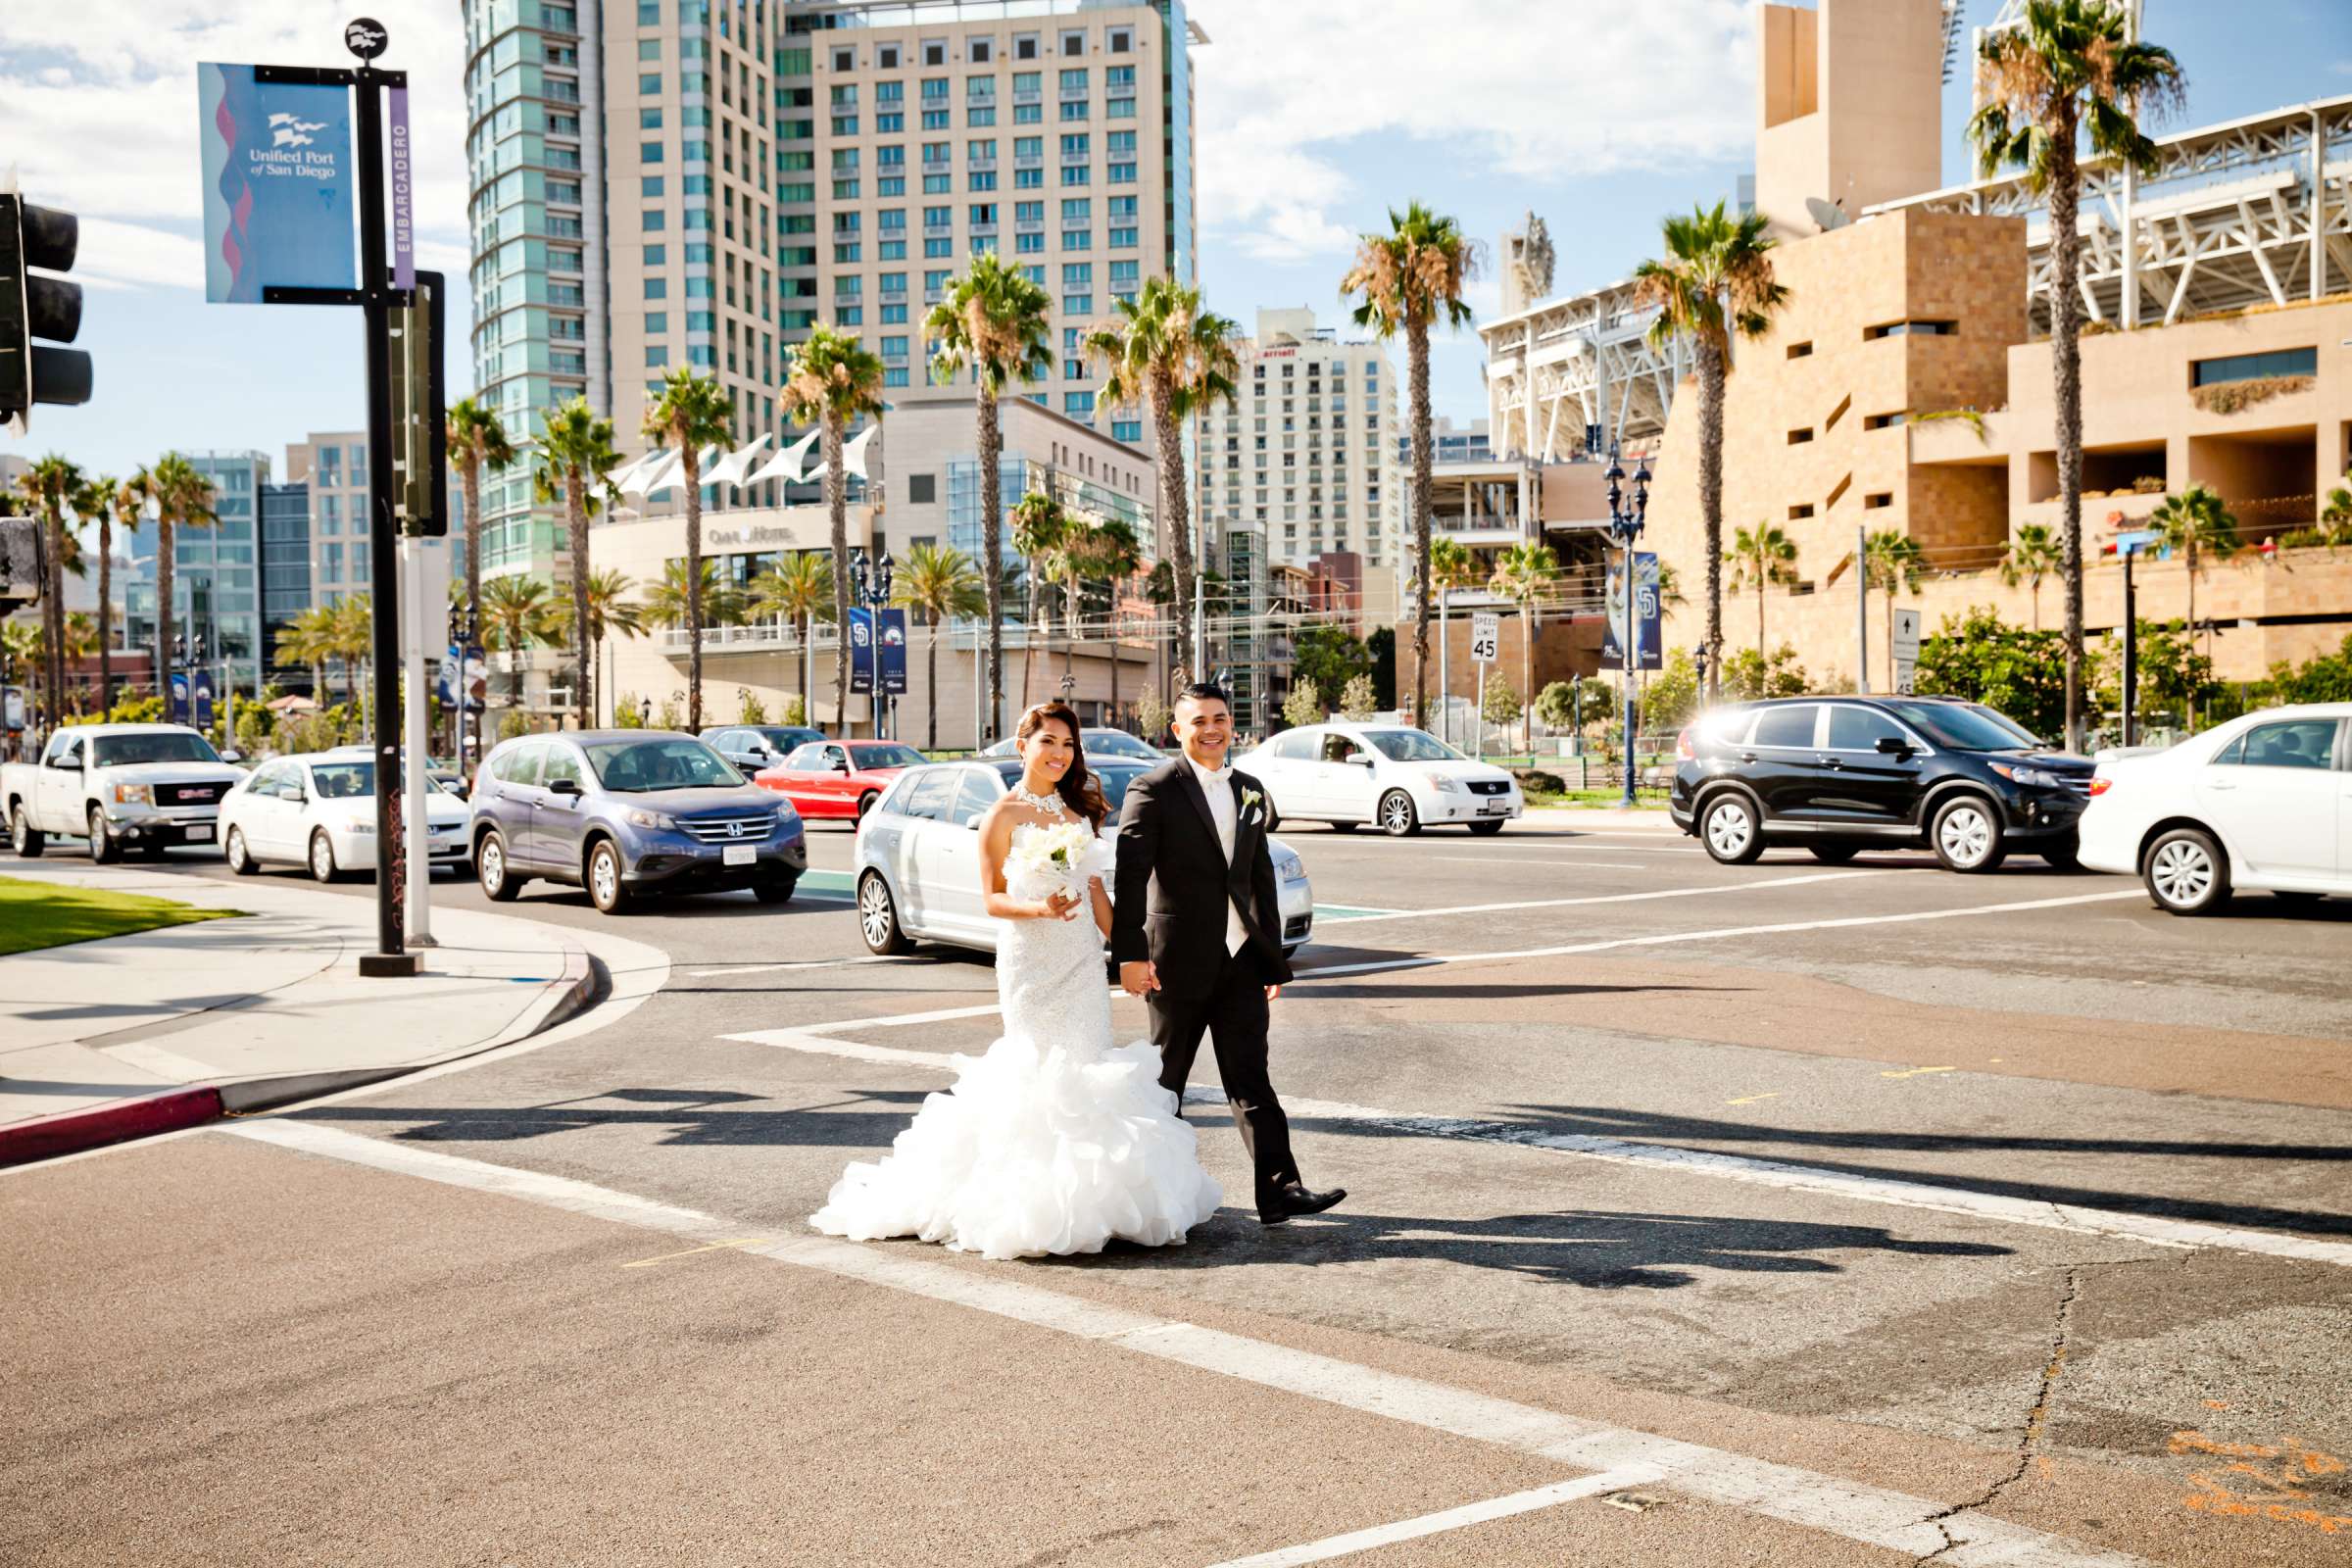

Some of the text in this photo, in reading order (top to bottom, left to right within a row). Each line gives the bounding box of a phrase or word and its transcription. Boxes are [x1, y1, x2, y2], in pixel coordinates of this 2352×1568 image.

[250, 149, 334, 165] Unified Port
[251, 164, 335, 180] of San Diego
[393, 124, 411, 252] EMBARCADERO
[1474, 616, 1497, 626] SPEED
[1474, 640, 1494, 658] 45
